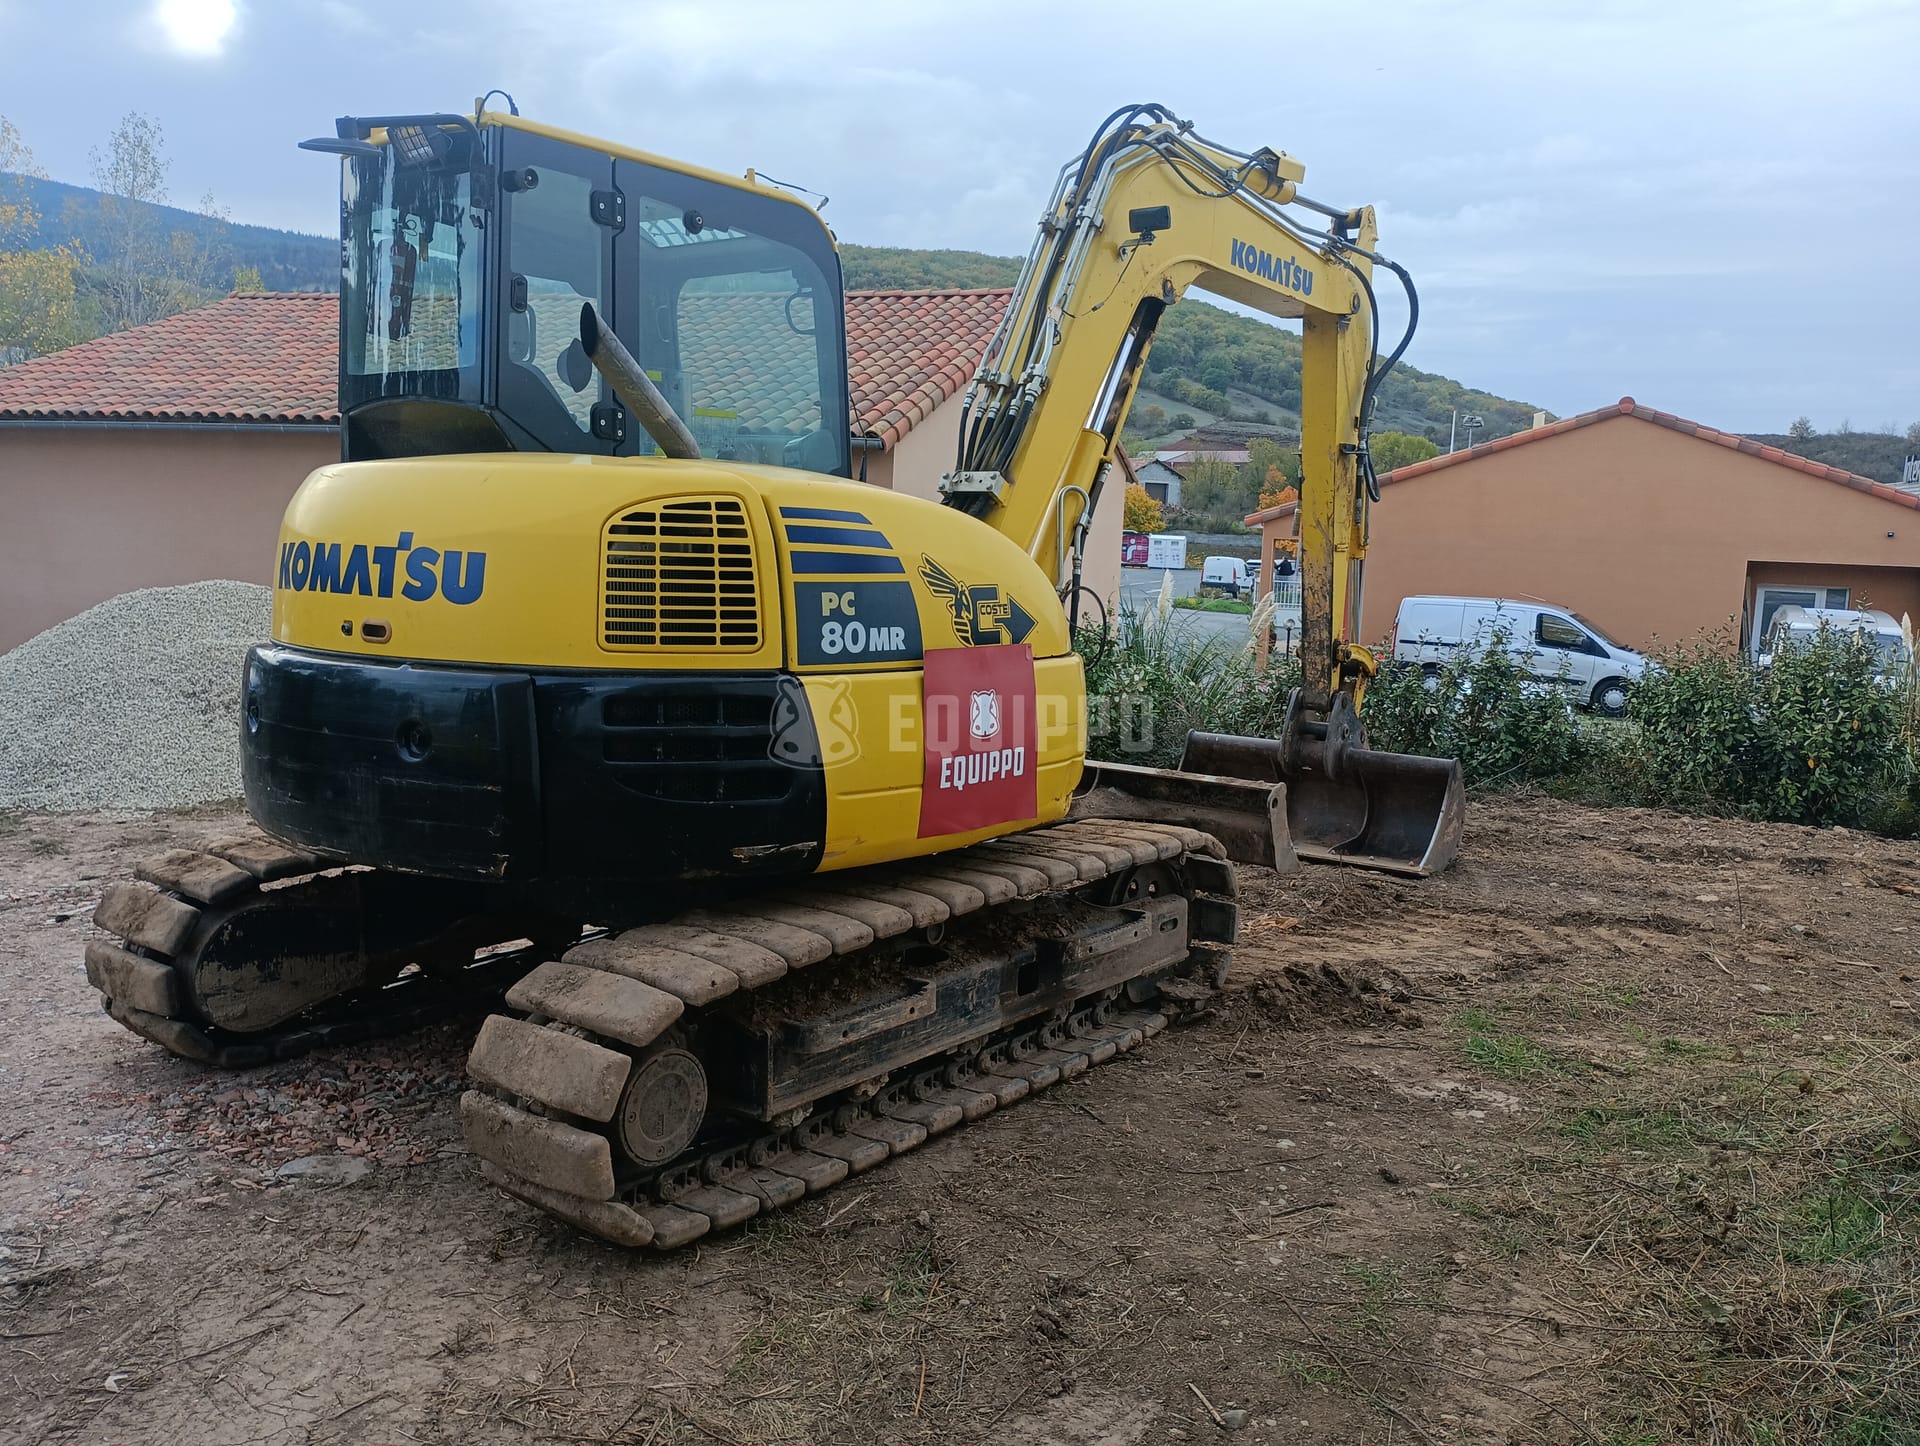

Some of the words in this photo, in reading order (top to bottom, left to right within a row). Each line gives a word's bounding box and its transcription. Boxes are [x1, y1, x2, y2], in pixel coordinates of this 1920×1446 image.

[1231, 238, 1313, 296] KOMATSU
[278, 531, 487, 605] KOMATSU
[821, 591, 856, 616] PC
[979, 603, 1009, 615] COSTE
[939, 746, 1025, 791] EQUIPPO
